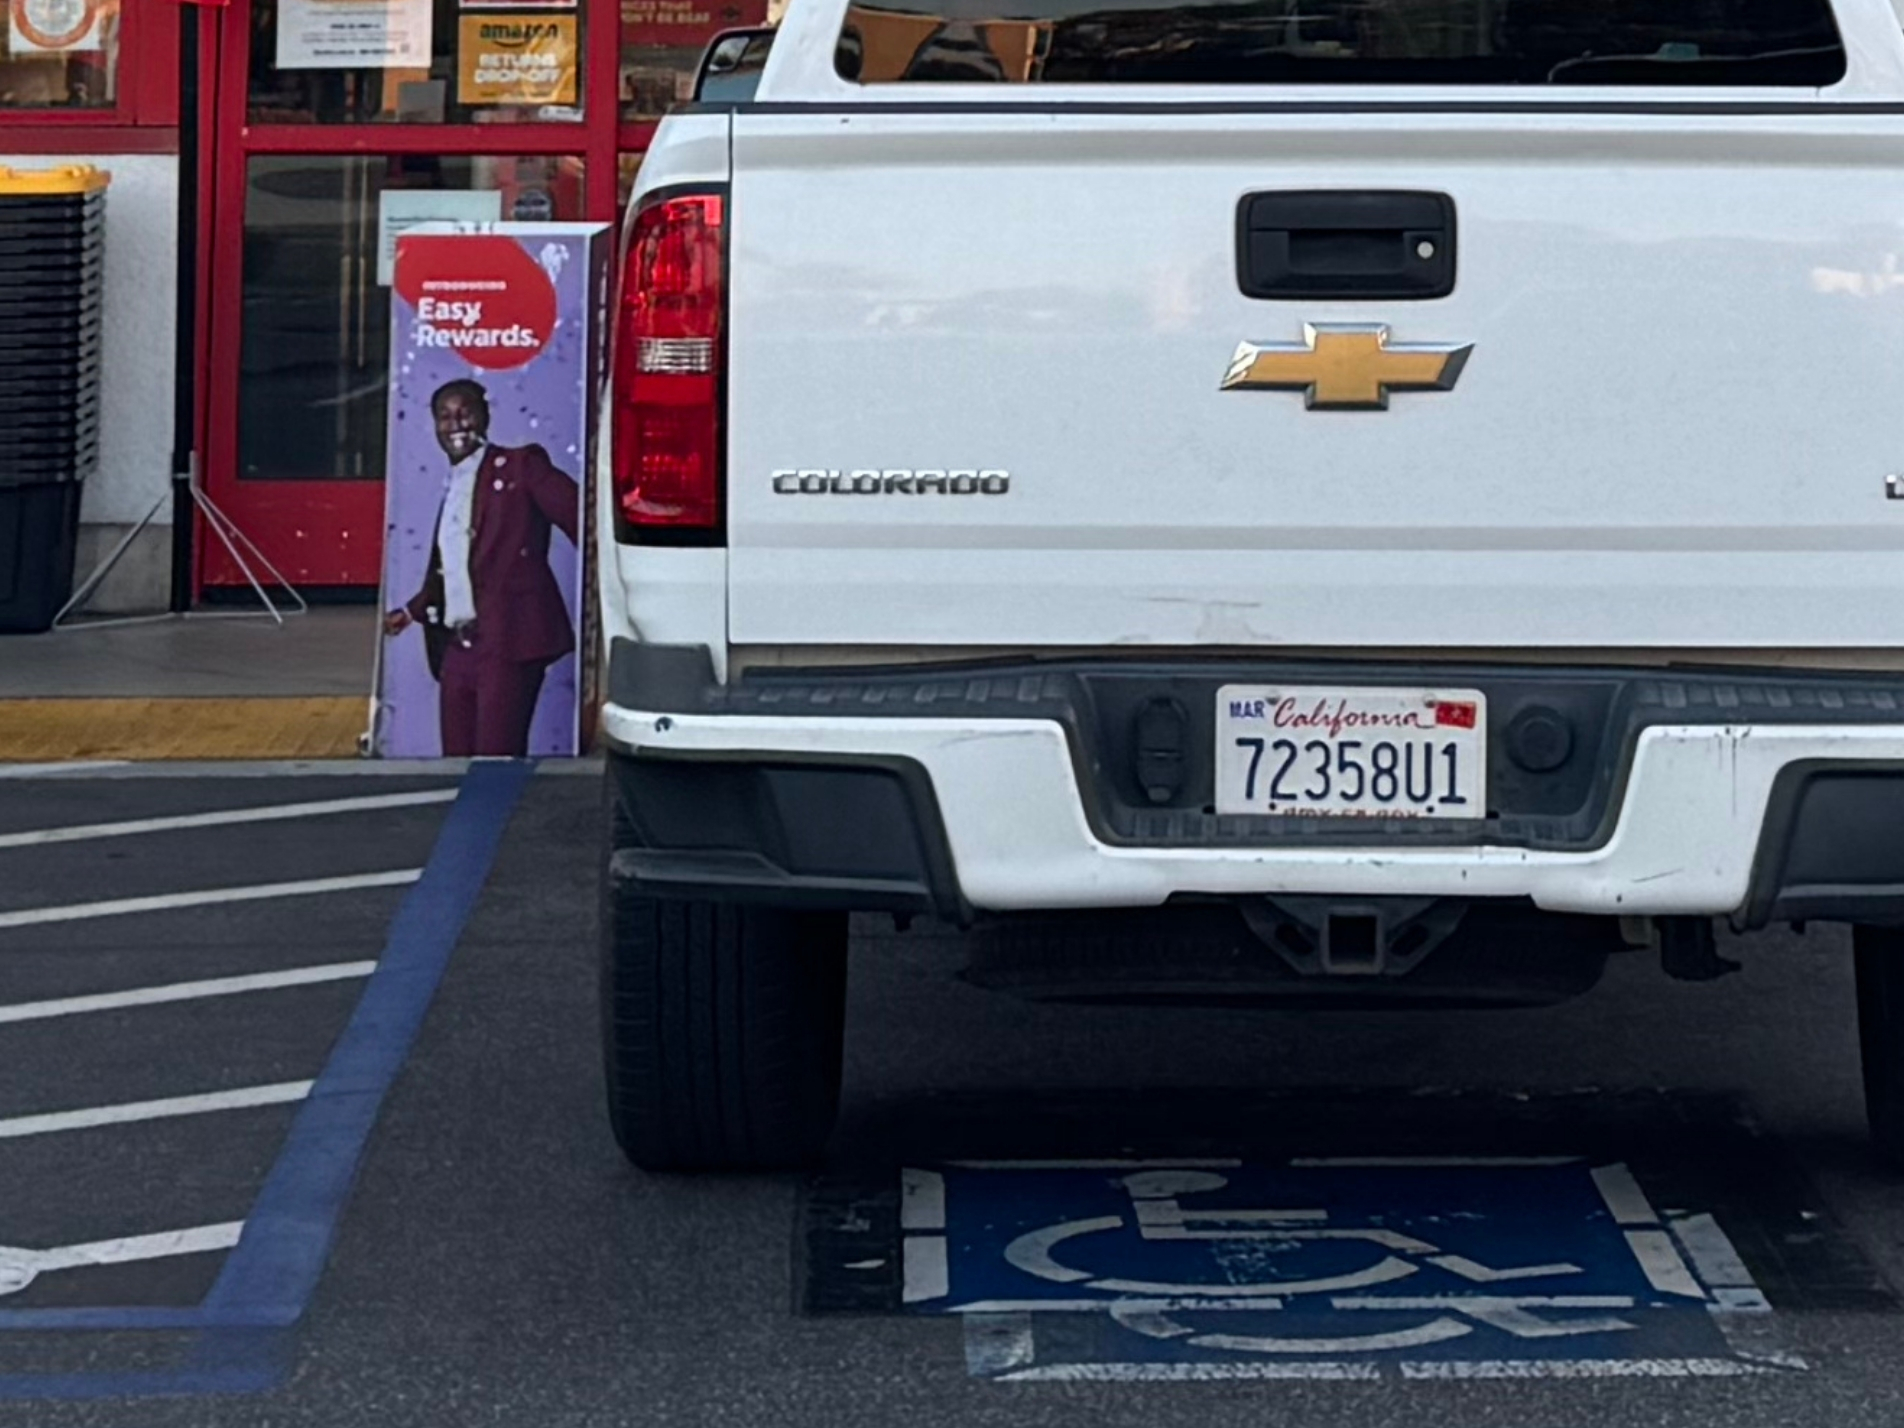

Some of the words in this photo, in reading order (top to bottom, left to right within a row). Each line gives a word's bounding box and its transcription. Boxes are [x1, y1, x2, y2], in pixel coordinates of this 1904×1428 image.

[479, 22, 559, 39] amazon
[418, 296, 482, 326] Easy
[416, 323, 541, 347] Rewards.
[771, 470, 1010, 495] COLORADO
[1229, 700, 1265, 719] MAR
[1273, 696, 1436, 739] California
[1235, 737, 1467, 804] 72358U1
